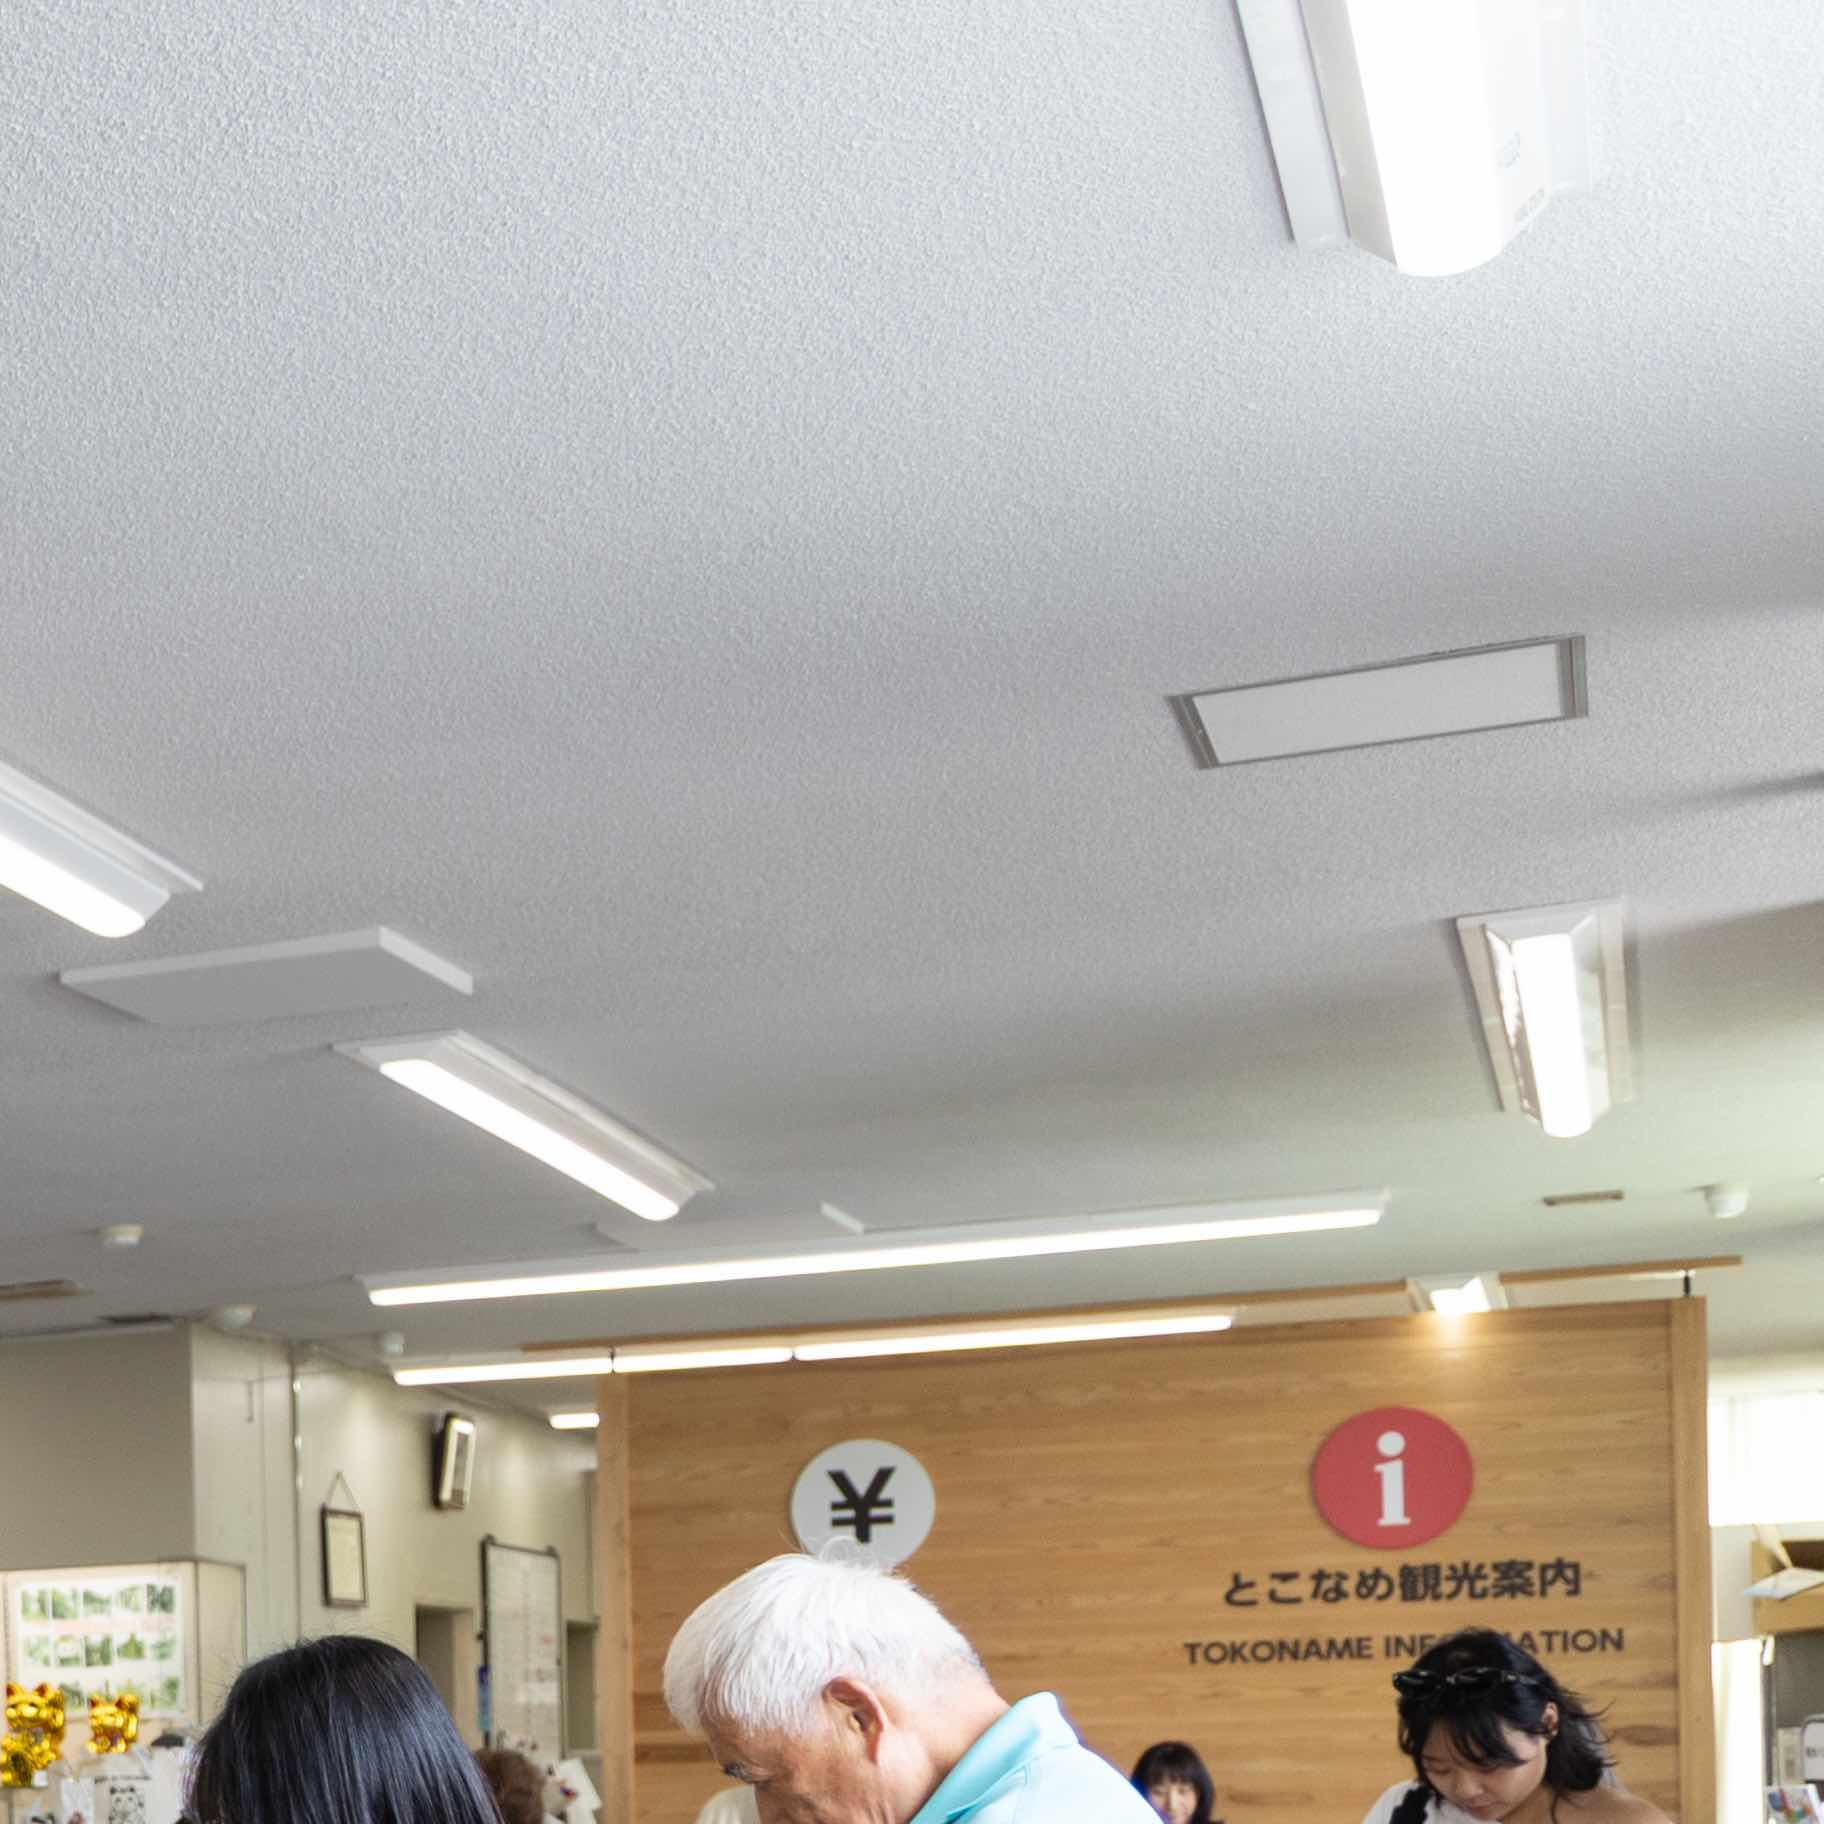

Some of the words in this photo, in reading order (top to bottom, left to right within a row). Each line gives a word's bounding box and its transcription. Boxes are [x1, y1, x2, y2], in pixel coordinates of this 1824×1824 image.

[1224, 1558, 1582, 1607] とこなめ観光案内
[1184, 1636, 1373, 1665] TOKONAME
[1385, 1628, 1624, 1659] INFATION
